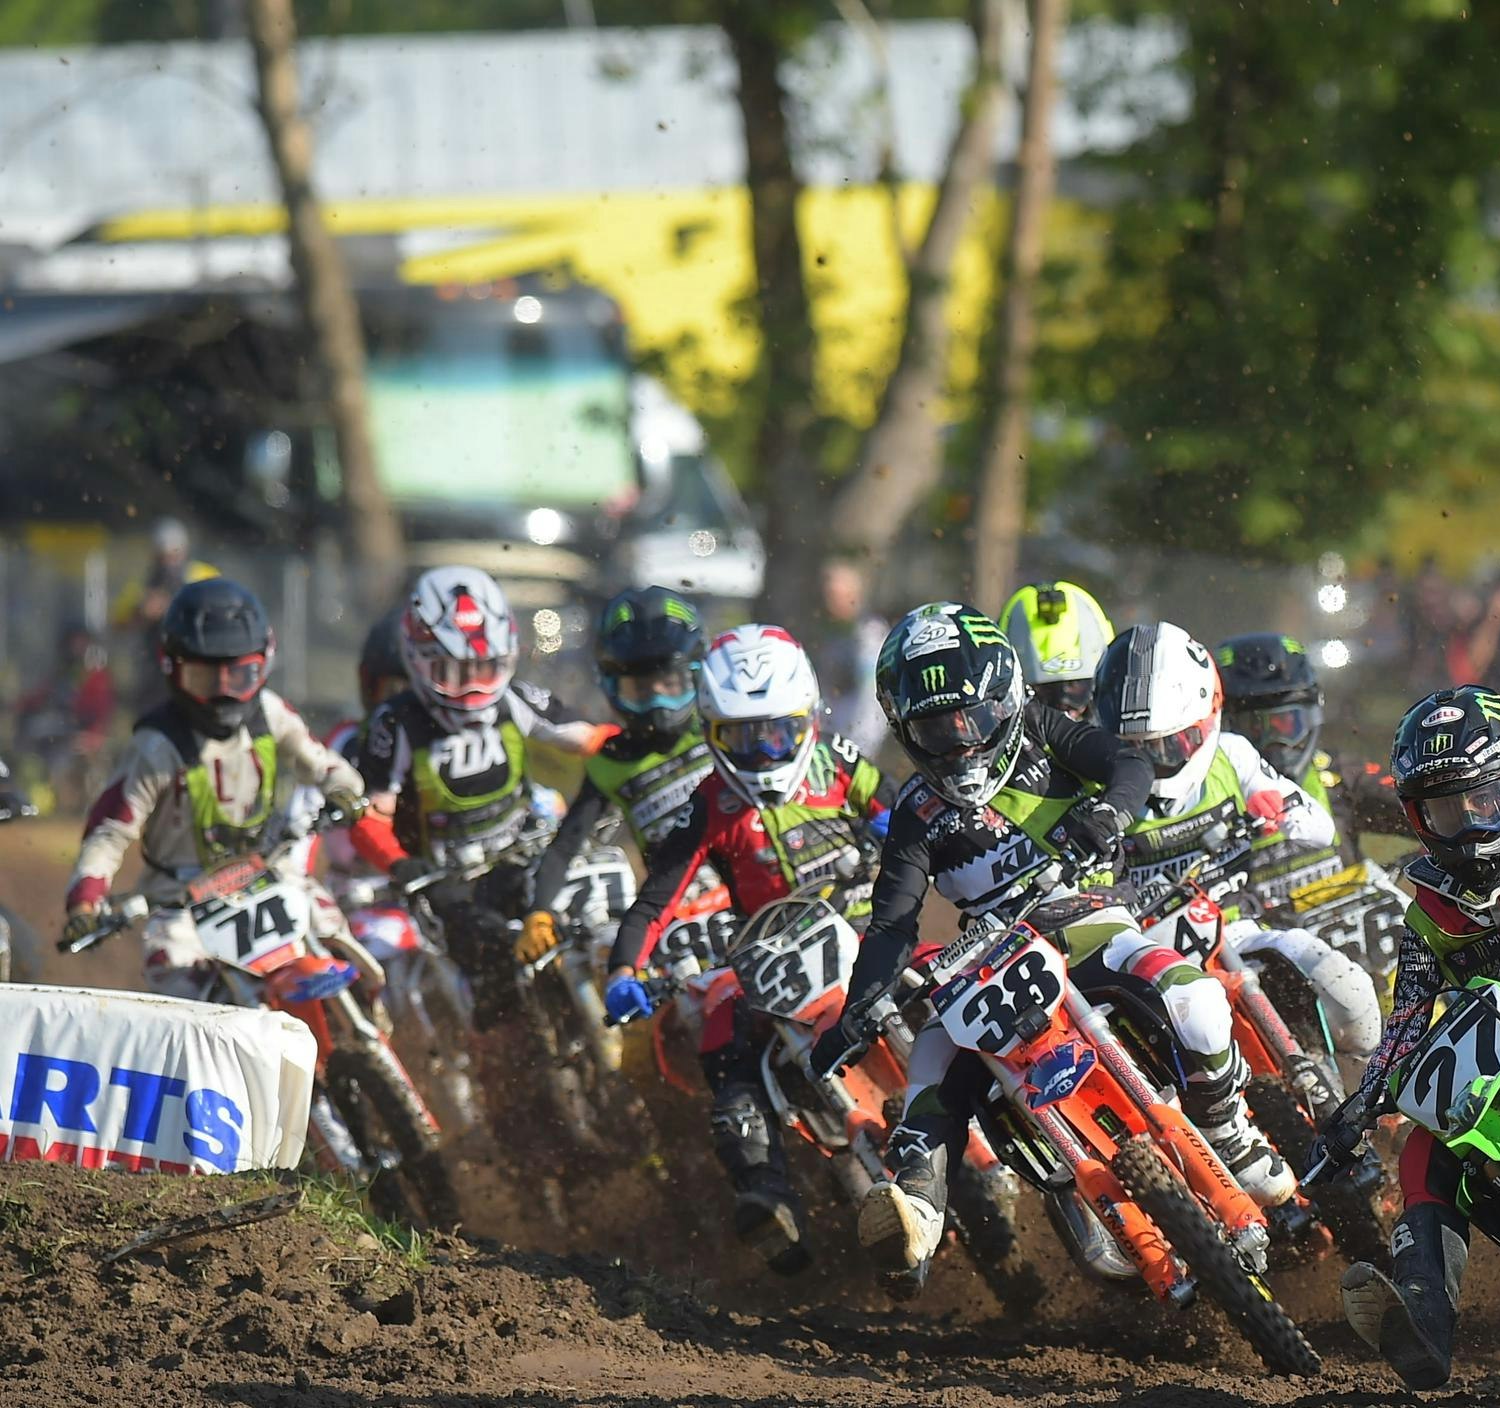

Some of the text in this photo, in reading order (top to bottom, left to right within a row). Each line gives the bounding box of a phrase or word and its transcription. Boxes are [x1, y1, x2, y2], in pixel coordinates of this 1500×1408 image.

[1428, 710, 1458, 723] BELL
[430, 726, 506, 780] FOX
[215, 895, 297, 959] 74
[962, 951, 1061, 1053] 38
[0, 1053, 243, 1175] RTS
[1183, 1127, 1233, 1190] DUNLOP
